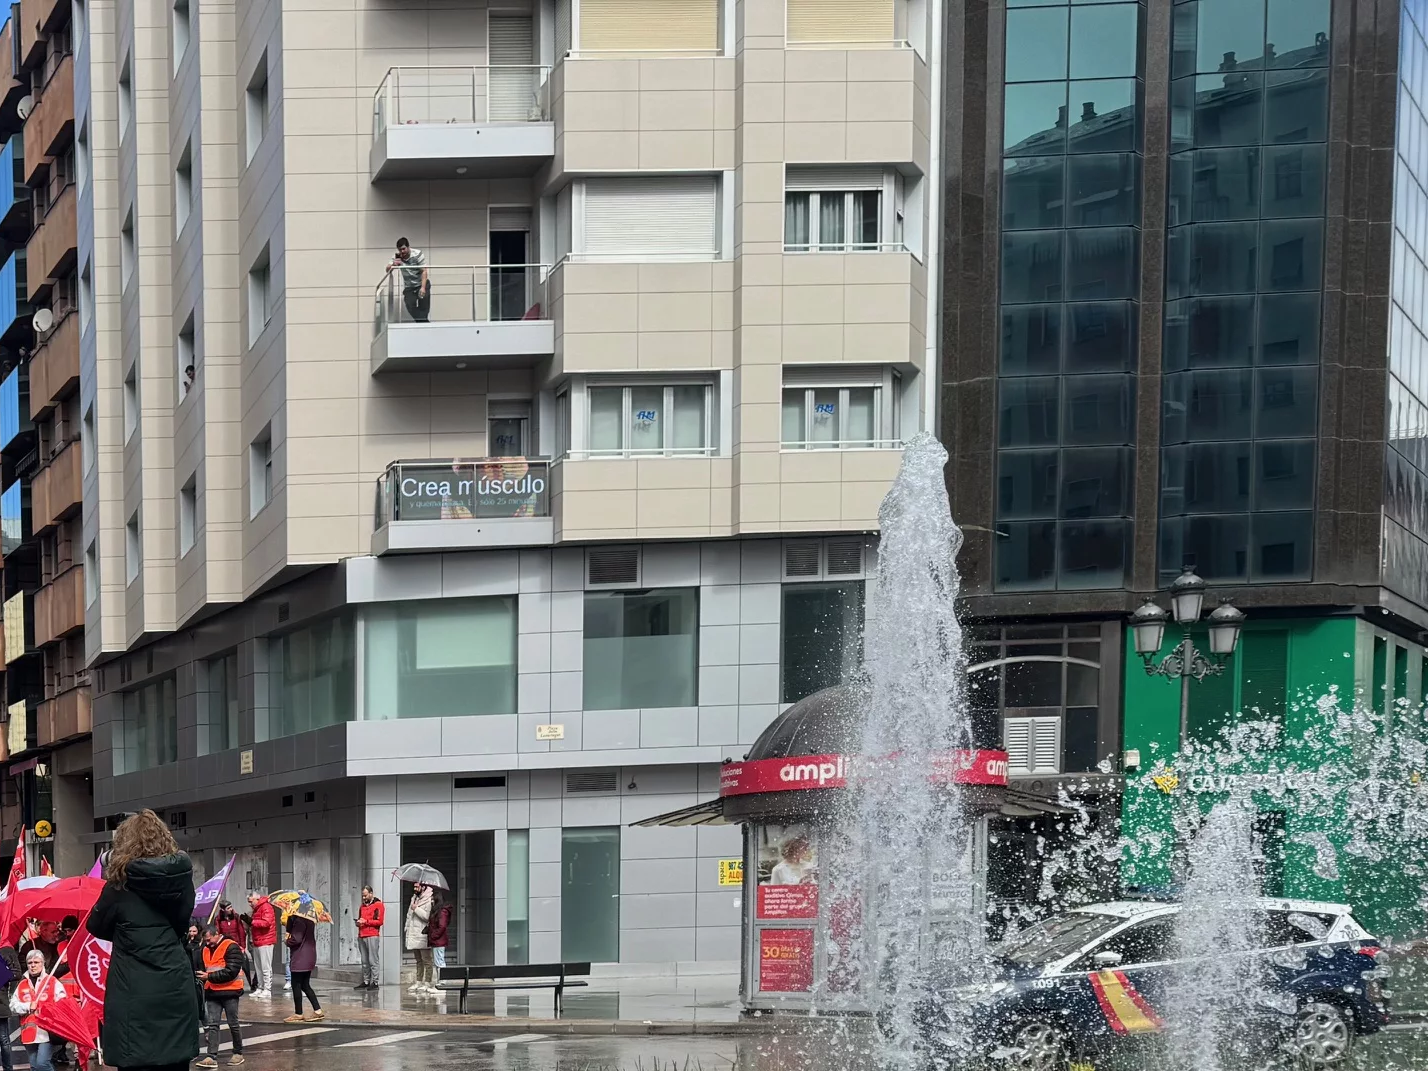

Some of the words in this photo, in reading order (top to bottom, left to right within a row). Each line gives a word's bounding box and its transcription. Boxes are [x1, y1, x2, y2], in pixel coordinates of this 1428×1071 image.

[401, 478, 451, 496] Crea
[459, 475, 544, 495] músculo
[779, 757, 849, 785] ampli
[762, 946, 780, 958] 30
